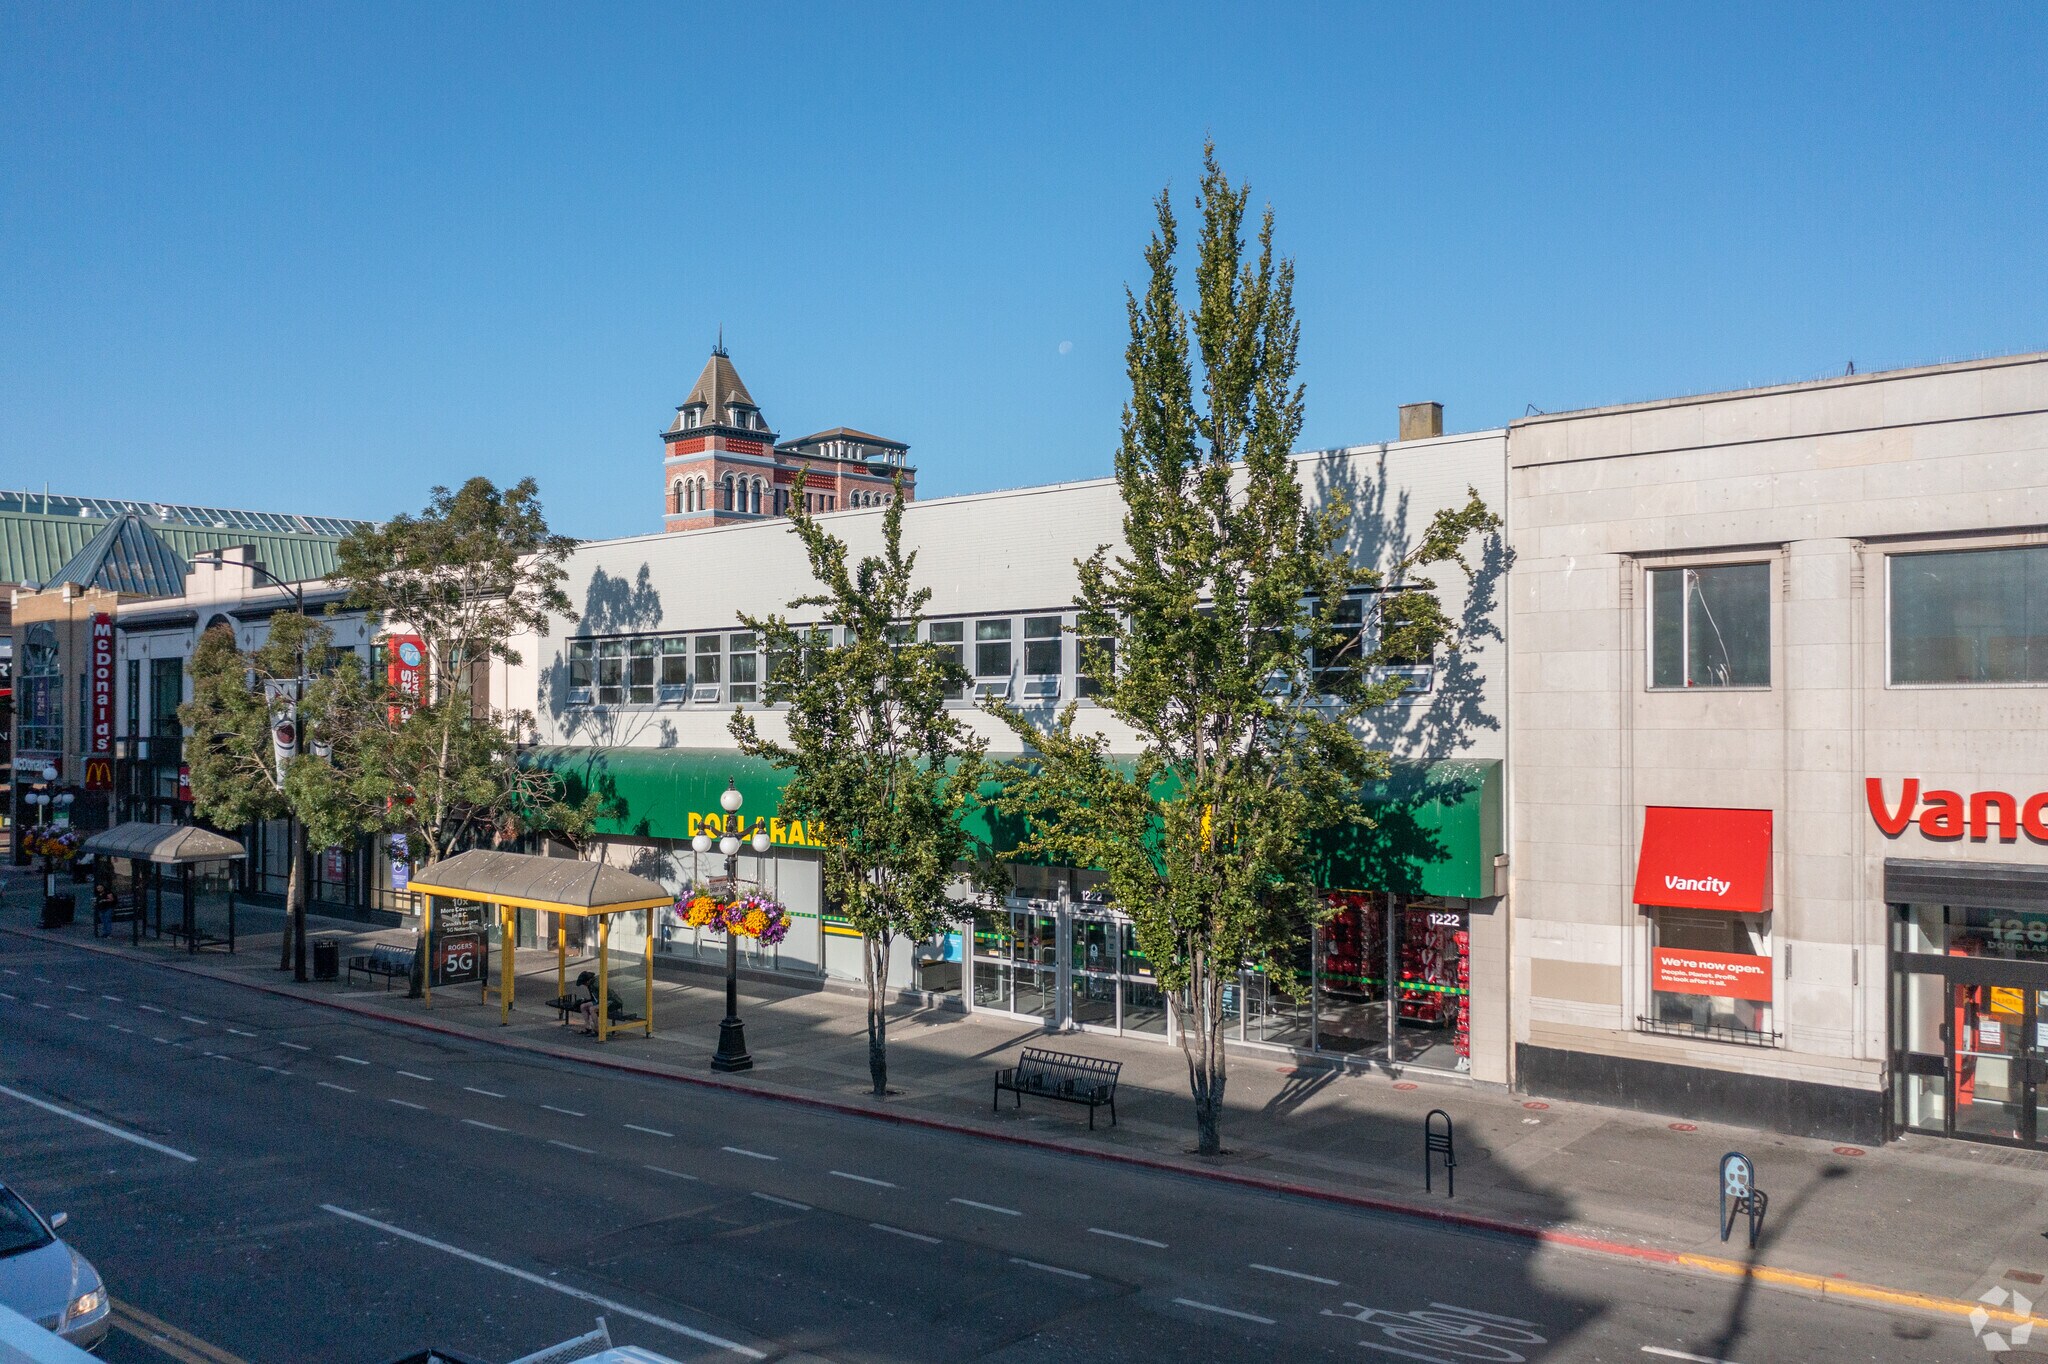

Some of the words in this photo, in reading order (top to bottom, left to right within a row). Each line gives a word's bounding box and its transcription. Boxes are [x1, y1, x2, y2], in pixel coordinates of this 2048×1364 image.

[94, 624, 112, 750] McDonald's
[1865, 778, 2048, 840] Vanc
[1665, 875, 1731, 896] Vancity
[1081, 890, 1103, 901] 1222
[1430, 913, 1460, 926] 1222
[448, 943, 472, 951] ROGERS
[1987, 941, 2048, 952] DOUGLAS
[446, 952, 473, 972] 5G
[1661, 957, 1697, 968] We're
[1699, 961, 1725, 970] now
[1727, 964, 1764, 974] open.
[1661, 968, 1687, 976] People.
[1688, 971, 1714, 979] Planet.
[1715, 973, 1738, 981] Profit.
[1690, 977, 1708, 985] after
